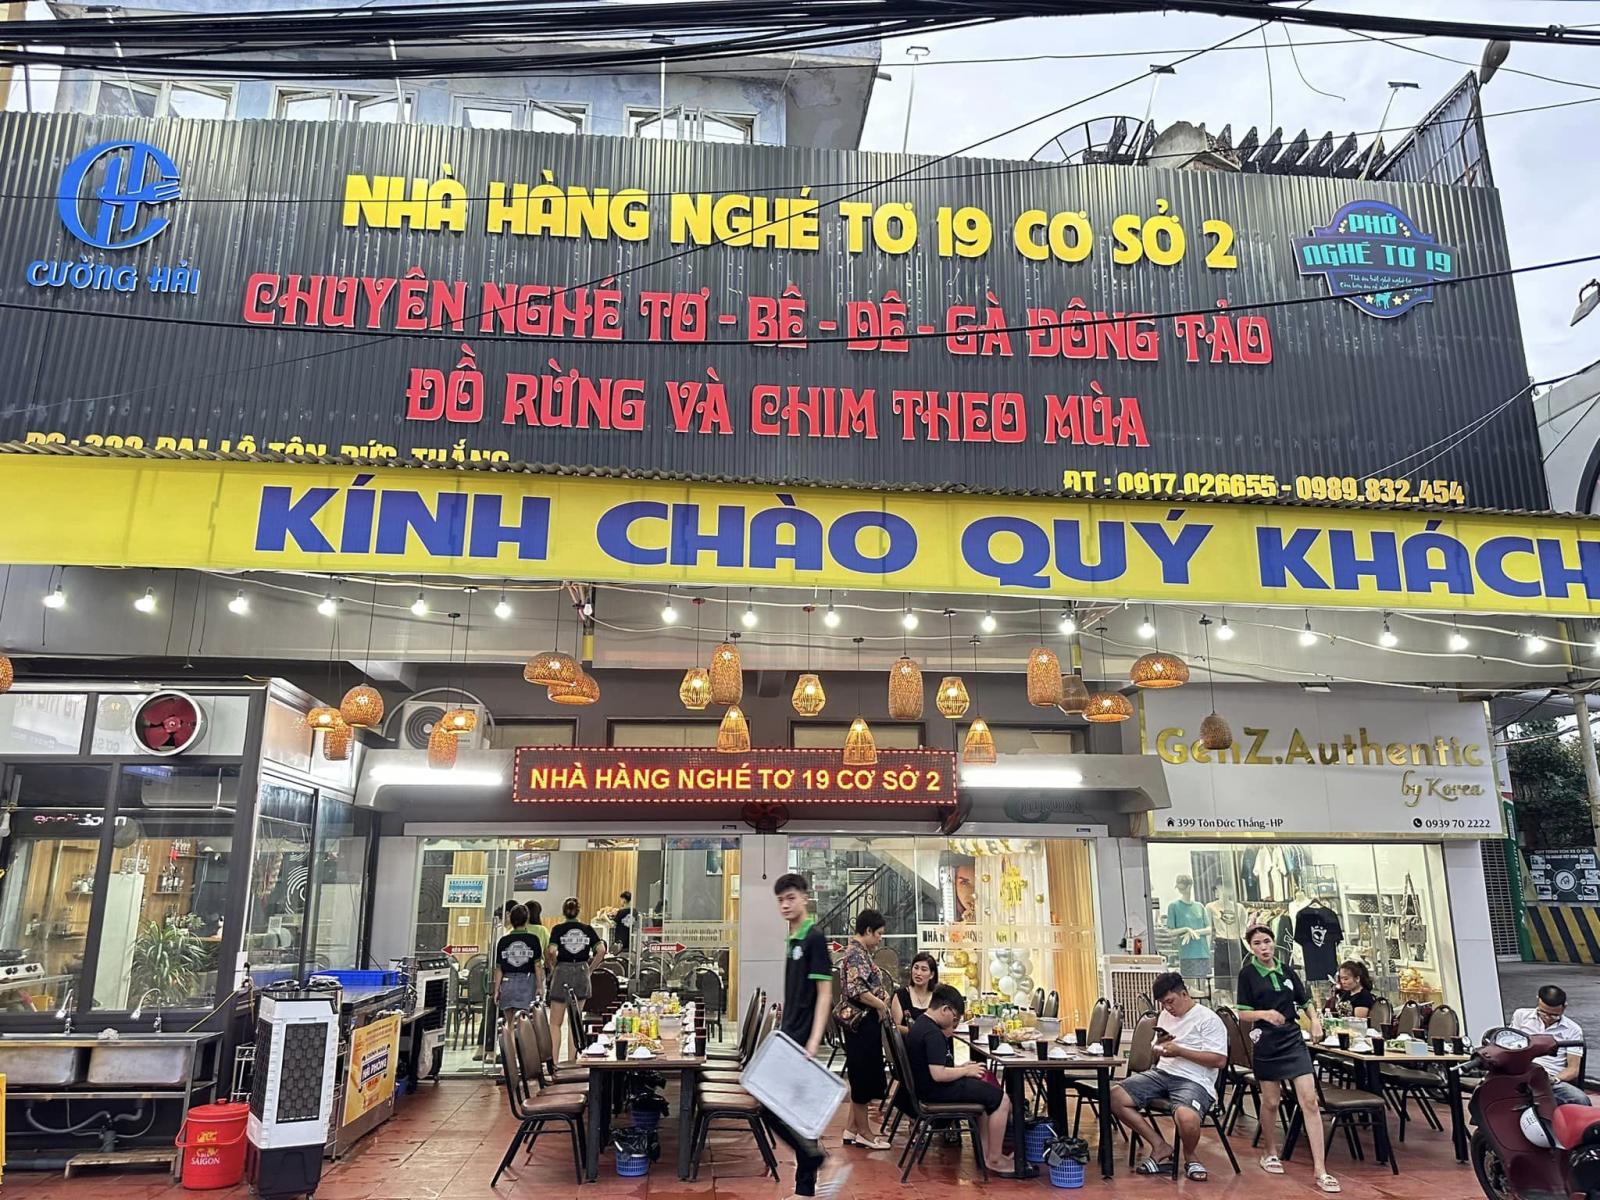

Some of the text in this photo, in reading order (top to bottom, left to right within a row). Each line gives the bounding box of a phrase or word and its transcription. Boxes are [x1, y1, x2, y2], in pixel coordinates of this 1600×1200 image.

[343, 164, 1238, 269] NHÀ HÀNG NGHÉ TƠ 19 CƠ SỞ 2
[1303, 241, 1451, 273] NGHÉ TƠ 19
[26, 257, 200, 295] CƯỜNG HẢI
[245, 266, 467, 332] CHUYÊN
[481, 276, 623, 341] NGHÉ
[640, 286, 710, 342] TƠ
[718, 315, 737, 324] -
[748, 284, 807, 348] BÊ
[819, 320, 837, 331] -
[847, 290, 909, 352] DÊ
[946, 291, 1014, 357] GÀ
[1026, 298, 1159, 362] ĐÔNG
[1174, 300, 1273, 365] TẢO
[406, 342, 1151, 448] ĐỒ RỪNG VÀ CHIM THEO MÙA
[1063, 470, 1097, 493] ĐT
[1118, 472, 1276, 497] 0917.026655
[1296, 476, 1465, 504] 0989.832.454
[255, 474, 1600, 599] KÍNH CHÀO QUÝ KHÁCH
[530, 761, 941, 791] NHÀ HÀNG NGHÉ TƠ 19 CƠ SỞ 2
[1401, 770, 1486, 807] by Korea
[1177, 819, 1195, 828] 399
[1198, 817, 1215, 828] Tôn
[1216, 817, 1235, 828] Đức
[1425, 819, 1491, 829] 0939 70 2222
[191, 1157, 220, 1165] SAIGON
